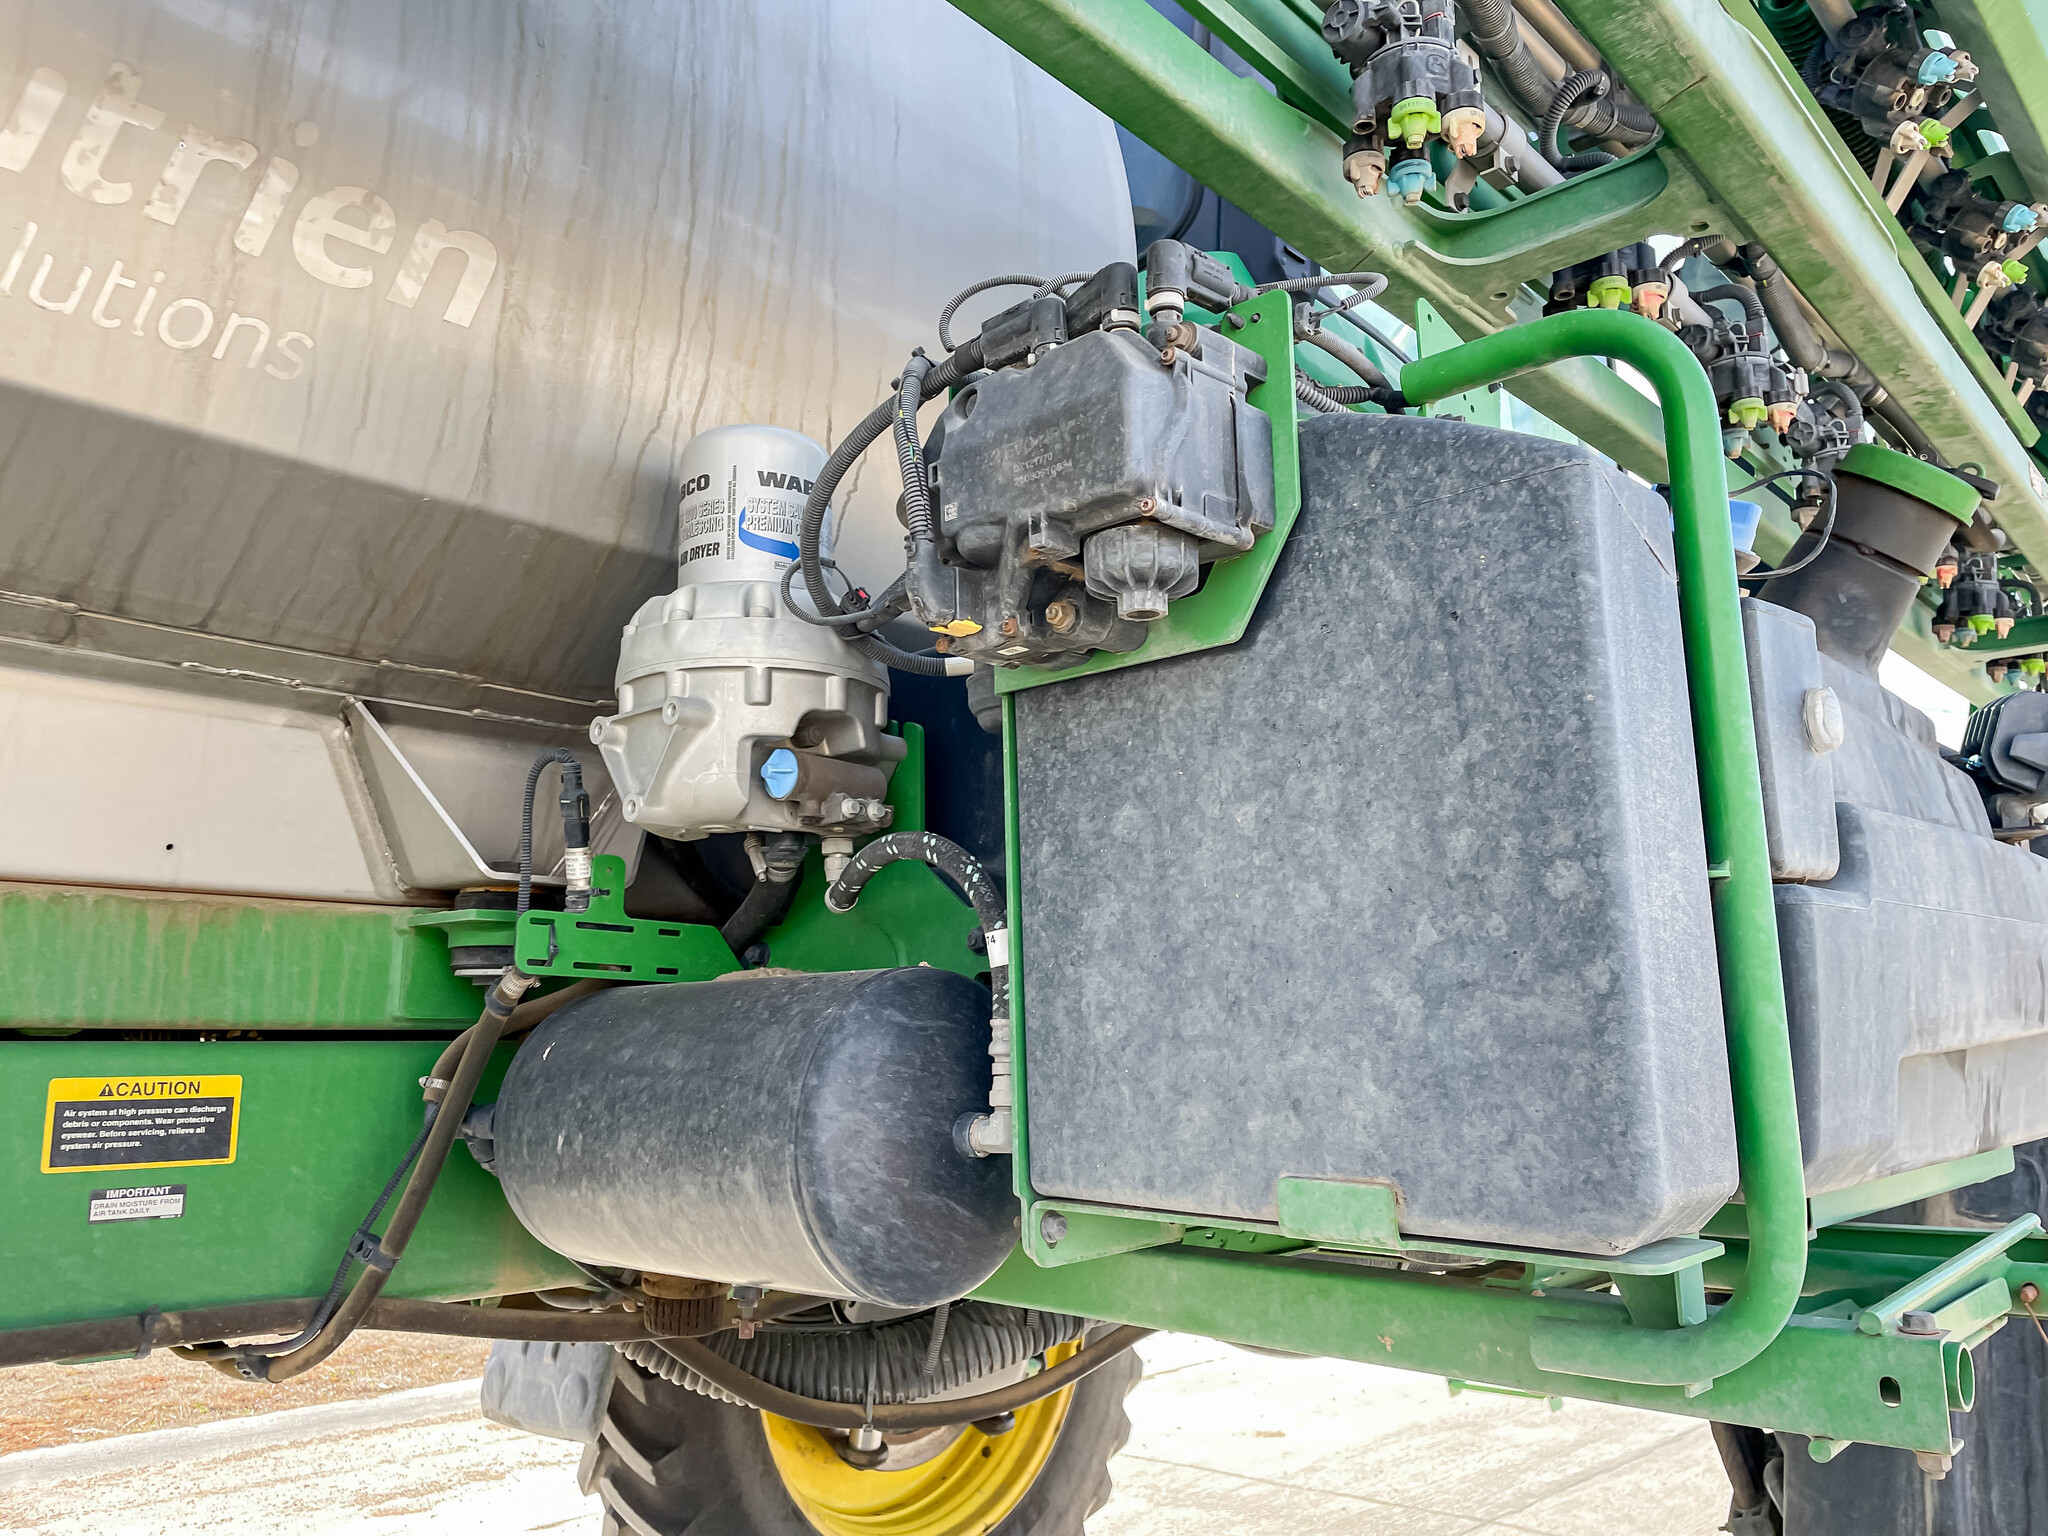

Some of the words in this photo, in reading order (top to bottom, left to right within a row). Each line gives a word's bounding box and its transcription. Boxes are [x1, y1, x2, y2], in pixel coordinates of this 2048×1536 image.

[746, 497, 787, 517] SYSTEM
[746, 514, 793, 535] PREMIUM
[689, 541, 720, 562] DRYER
[116, 1081, 201, 1096] CAUTION
[63, 1109, 77, 1117] Air
[78, 1108, 107, 1118] system
[109, 1108, 117, 1116] at
[118, 1107, 137, 1117] high
[138, 1107, 172, 1117] pressure
[174, 1106, 188, 1114] can
[190, 1105, 227, 1114] discharge
[62, 1119, 89, 1128] debris
[102, 1118, 154, 1129] components.
[155, 1117, 175, 1125] Wear
[176, 1116, 215, 1125] protective
[61, 1131, 98, 1141] eyewear.
[100, 1129, 126, 1138] Before
[128, 1128, 167, 1138] servicing,
[168, 1127, 194, 1136] relieve
[195, 1126, 206, 1134] all
[60, 1142, 90, 1151] system
[92, 1141, 103, 1149] air
[104, 1140, 143, 1150] pressure.
[106, 1186, 172, 1199] IMPORTANT
[93, 1202, 118, 1210] DRAIN
[119, 1199, 158, 1208] MOISTURE
[107, 1208, 128, 1216] TANK
[129, 1207, 150, 1215] DAILY
